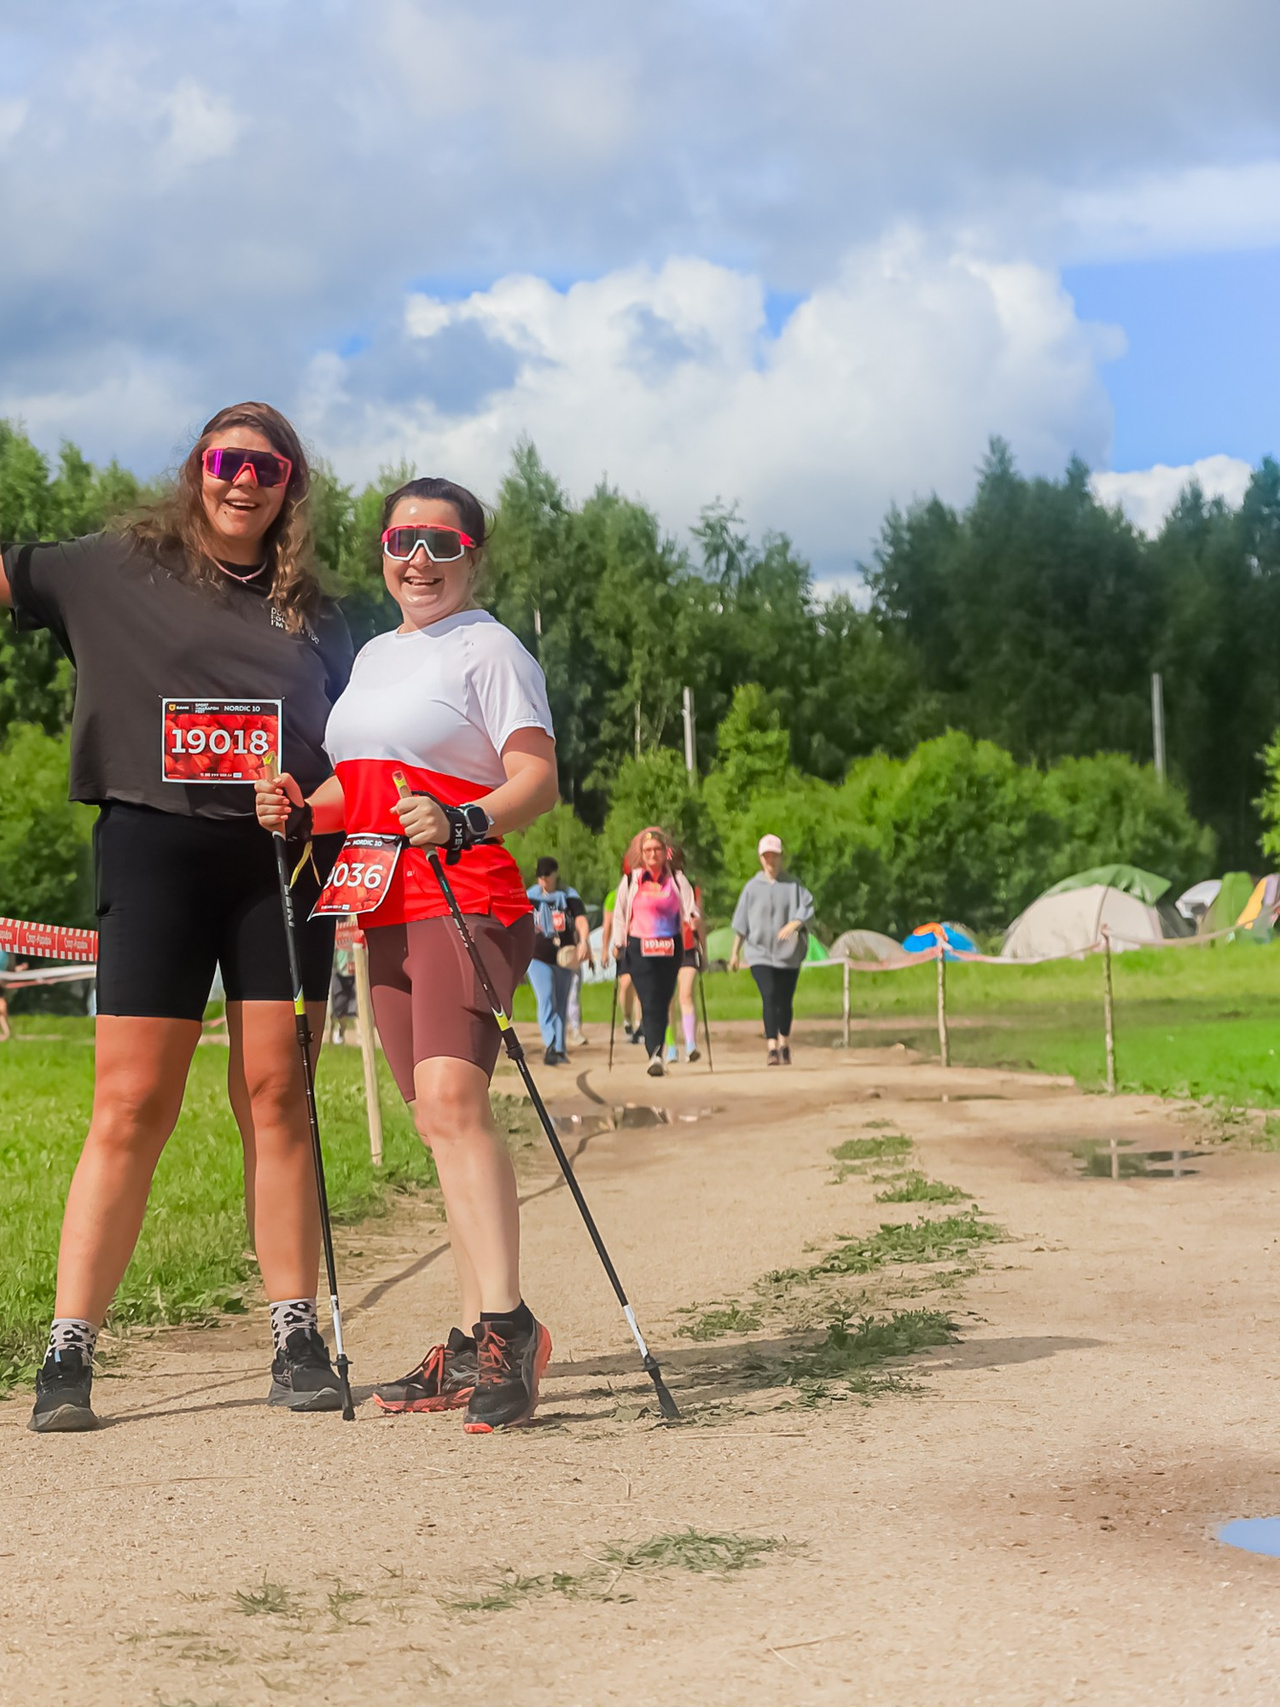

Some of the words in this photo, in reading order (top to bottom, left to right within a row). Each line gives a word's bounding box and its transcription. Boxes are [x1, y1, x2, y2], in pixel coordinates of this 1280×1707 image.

[224, 705, 251, 713] NORDIC
[252, 705, 261, 713] 10
[172, 729, 270, 755] 19018
[352, 839, 374, 847] NORDIC
